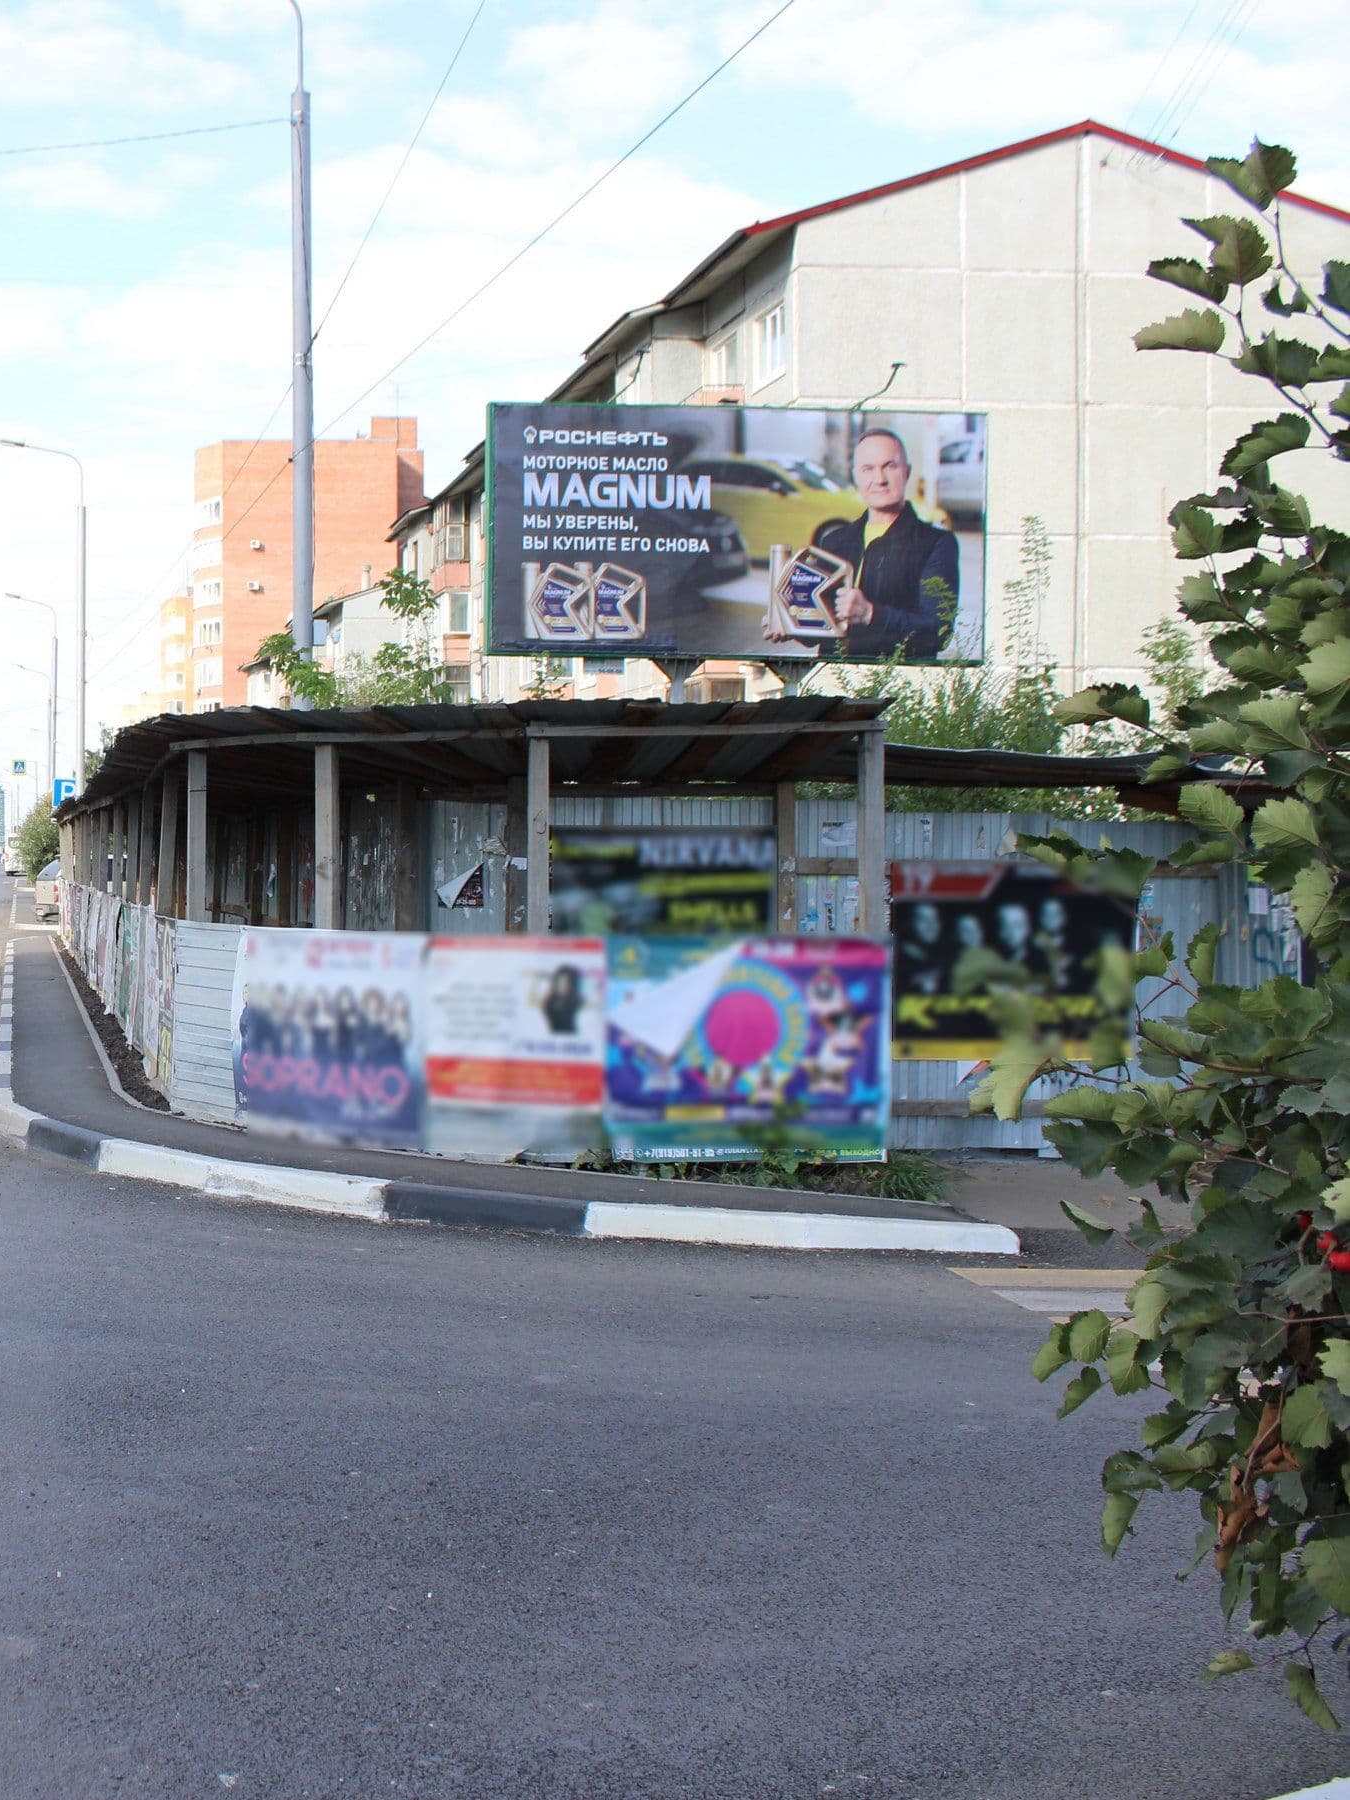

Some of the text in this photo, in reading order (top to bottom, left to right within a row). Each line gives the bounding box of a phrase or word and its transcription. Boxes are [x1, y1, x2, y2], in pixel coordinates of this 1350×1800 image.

[539, 429, 668, 446] РОСНЕФТЬ
[523, 455, 668, 472] МОТОРНОЕ МАСЛО
[523, 472, 711, 510] MAGNUM
[523, 515, 639, 533] МЫ УВЕРЕНЫ,
[523, 536, 710, 553] ВЫ КУПИТЕ ЕГО СНОВА
[60, 781, 76, 801] P
